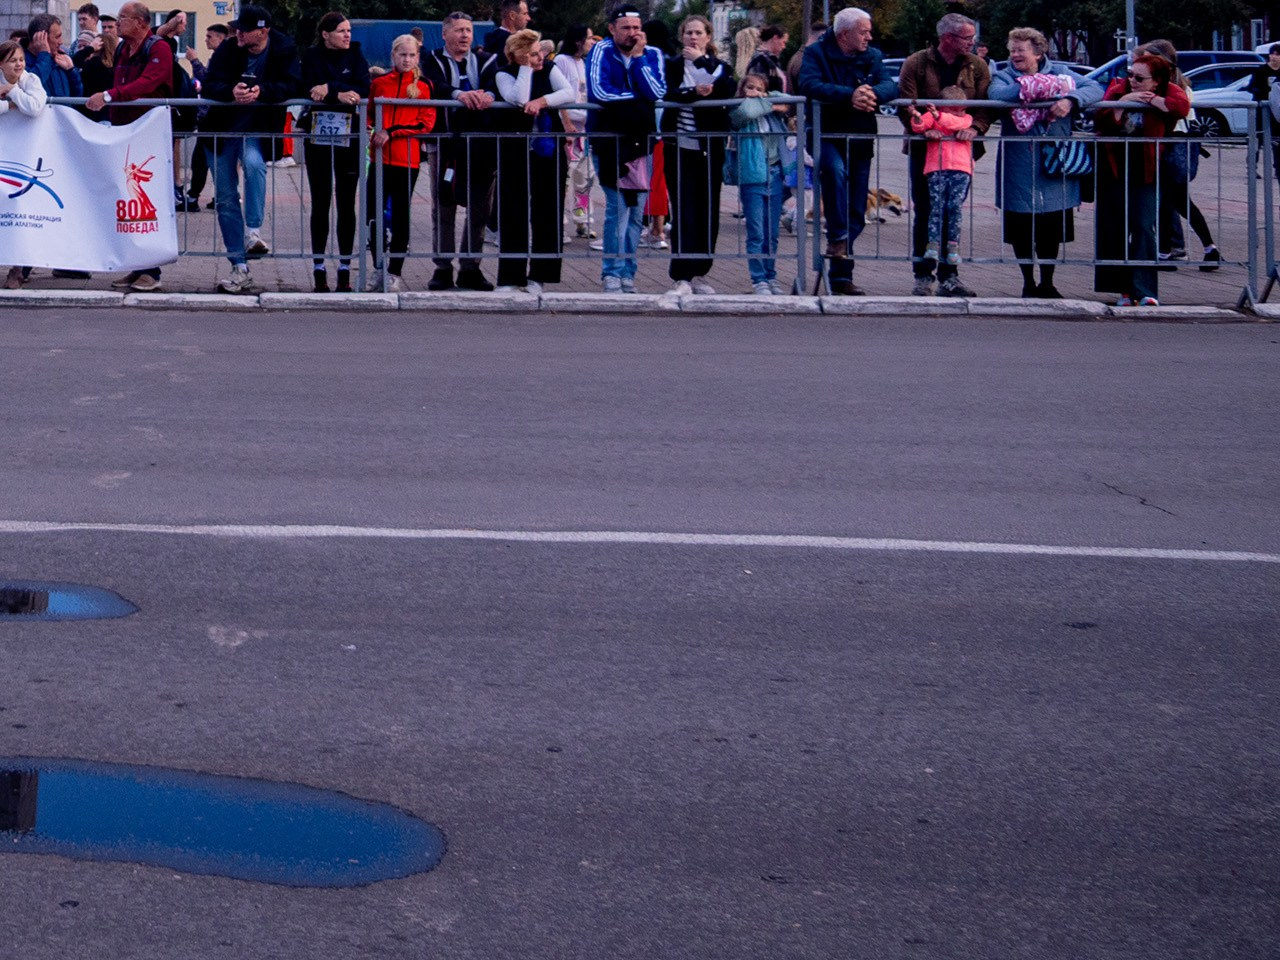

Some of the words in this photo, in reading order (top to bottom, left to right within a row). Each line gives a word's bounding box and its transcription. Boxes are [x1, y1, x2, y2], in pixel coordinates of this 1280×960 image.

[116, 199, 139, 221] 80
[28, 214, 62, 223] ФЕДЕРАЦИЯ
[14, 221, 44, 229] АТЛЕТИКИ
[116, 222, 159, 234] ПОБЕДА!
